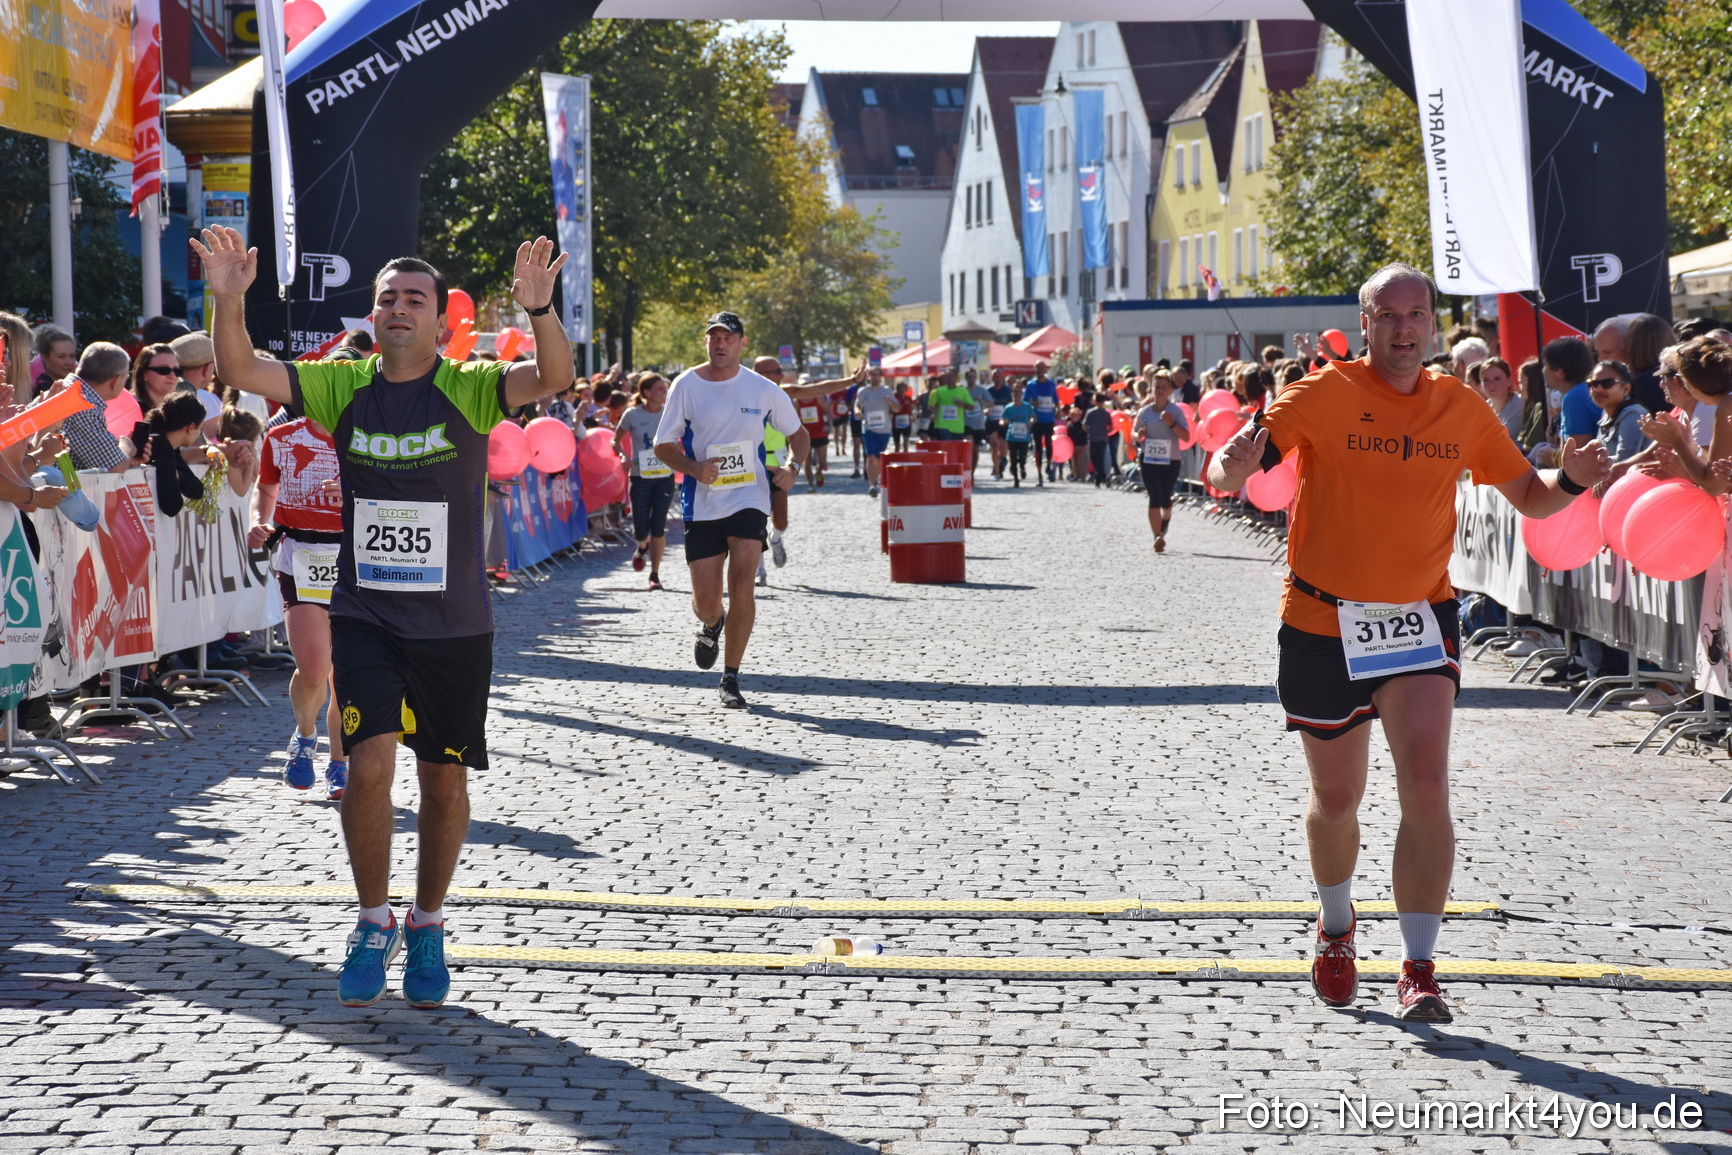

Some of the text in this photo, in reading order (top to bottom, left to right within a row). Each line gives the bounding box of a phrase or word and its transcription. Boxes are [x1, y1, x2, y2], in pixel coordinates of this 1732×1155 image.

[305, 52, 400, 114] PARTL
[1522, 43, 1615, 110] MARKT
[306, 331, 336, 342] NEXT
[268, 340, 321, 353] 100 EARS
[350, 425, 453, 459] BOCK
[1149, 446, 1167, 455] 2125
[1347, 434, 1460, 459] EURO POLES
[346, 451, 458, 470] inspired by smart concepts
[722, 476, 745, 484] Gerhard
[377, 508, 419, 519] BOCK
[366, 525, 432, 553] 2535
[172, 508, 236, 603] PARTL
[372, 567, 424, 581] Sleimann
[1355, 612, 1425, 643] 3129
[1386, 641, 1414, 650] Neumarkt
